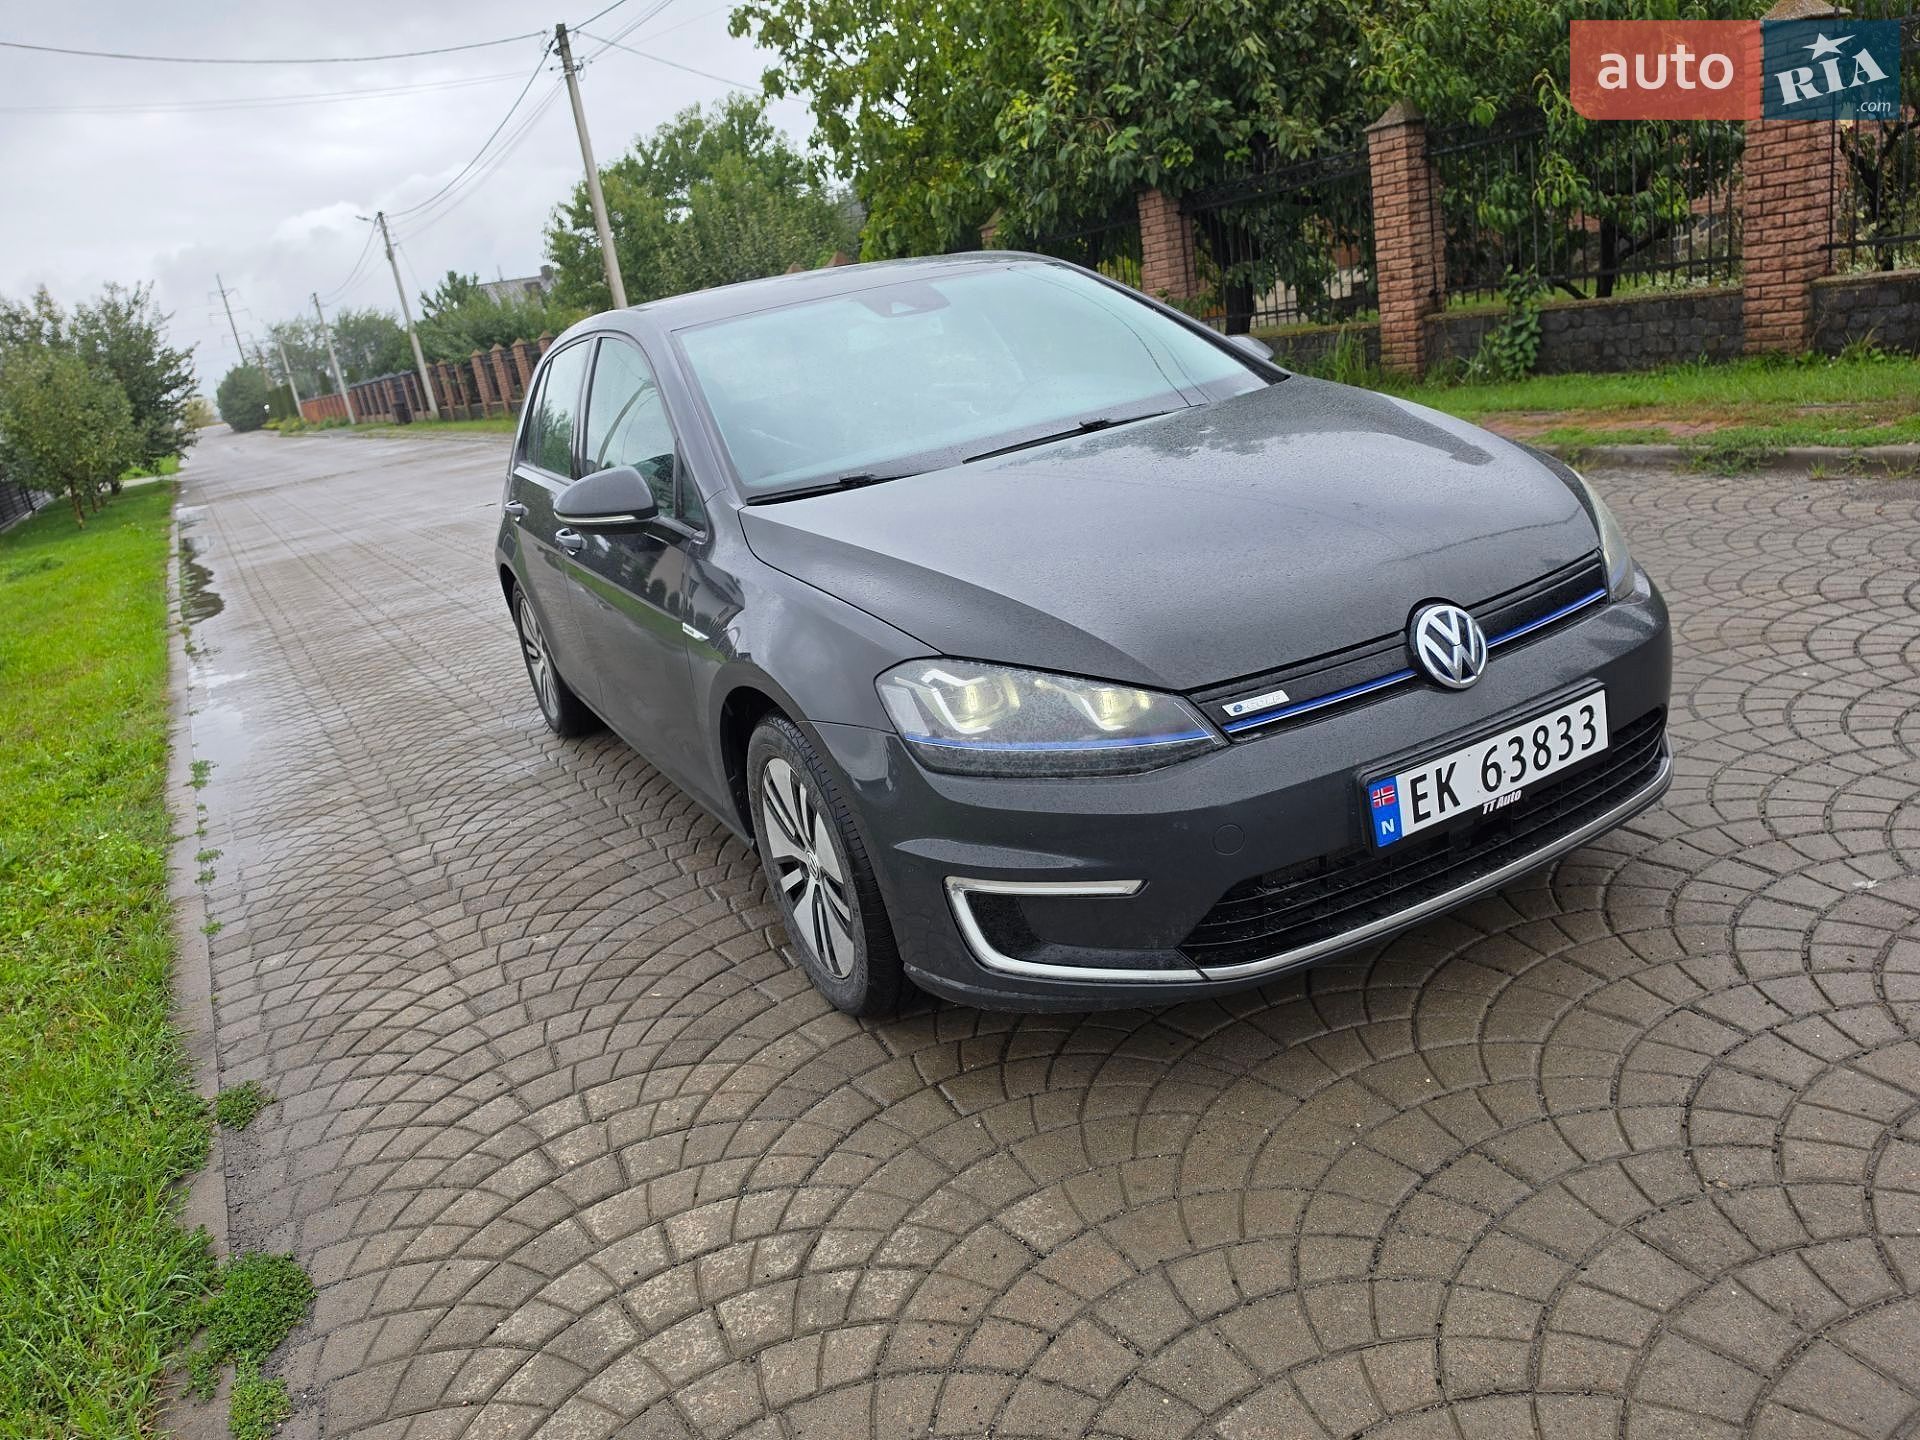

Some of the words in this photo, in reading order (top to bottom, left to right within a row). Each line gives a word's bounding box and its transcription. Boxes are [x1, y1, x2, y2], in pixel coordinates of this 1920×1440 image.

[1409, 761, 1461, 824] EK
[1480, 704, 1597, 793] 63833
[1496, 789, 1522, 809] Auto
[1381, 818, 1395, 836] N
